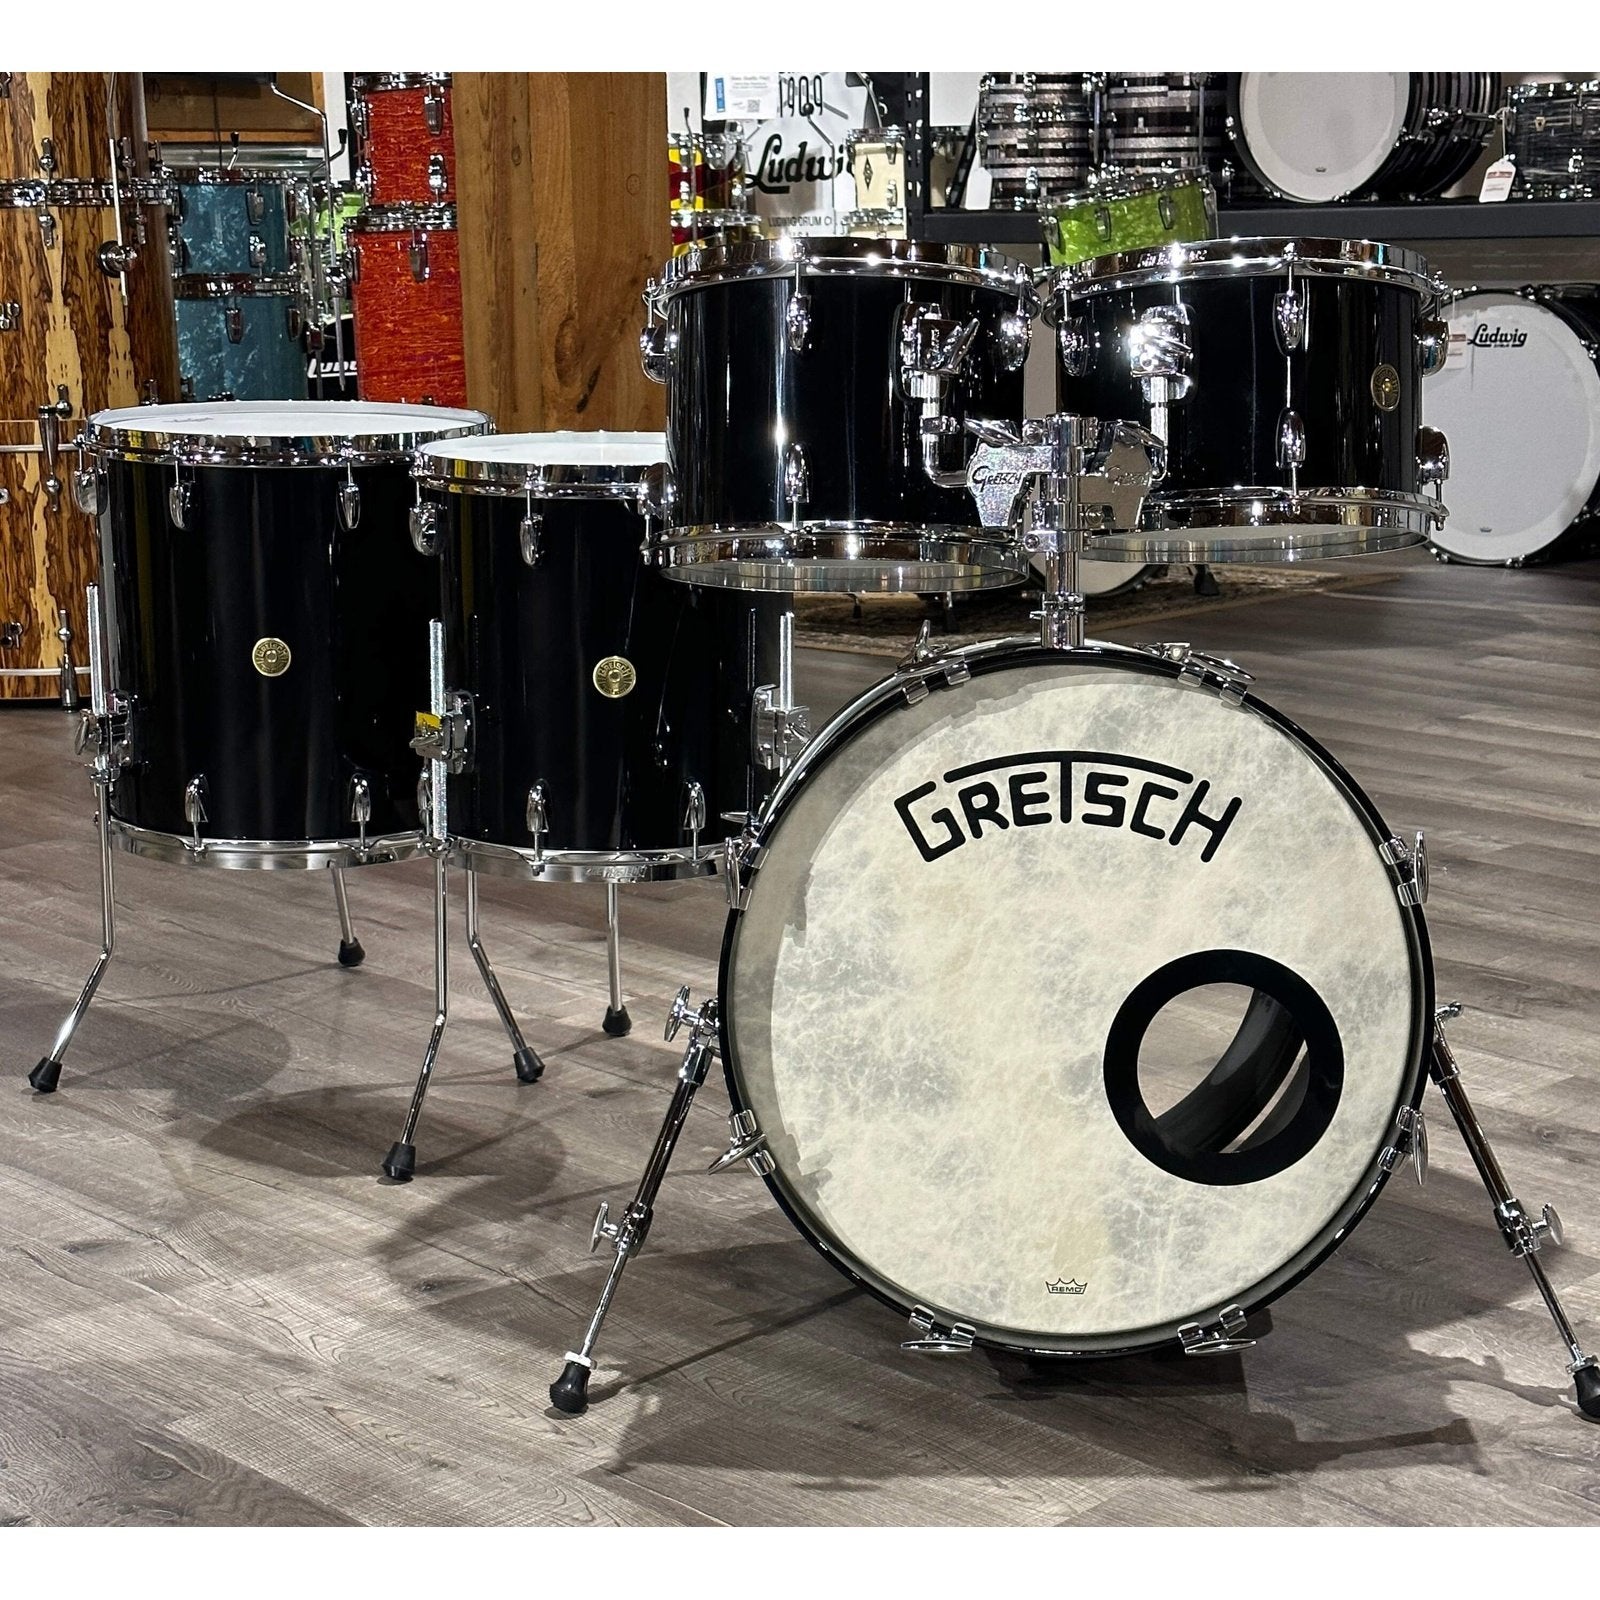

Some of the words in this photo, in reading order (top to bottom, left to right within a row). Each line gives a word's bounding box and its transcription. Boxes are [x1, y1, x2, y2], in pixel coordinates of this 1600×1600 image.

[1467, 323, 1528, 348] Ludwig
[971, 465, 1023, 492] GRETSCH
[894, 750, 1243, 863] GRETSCH
